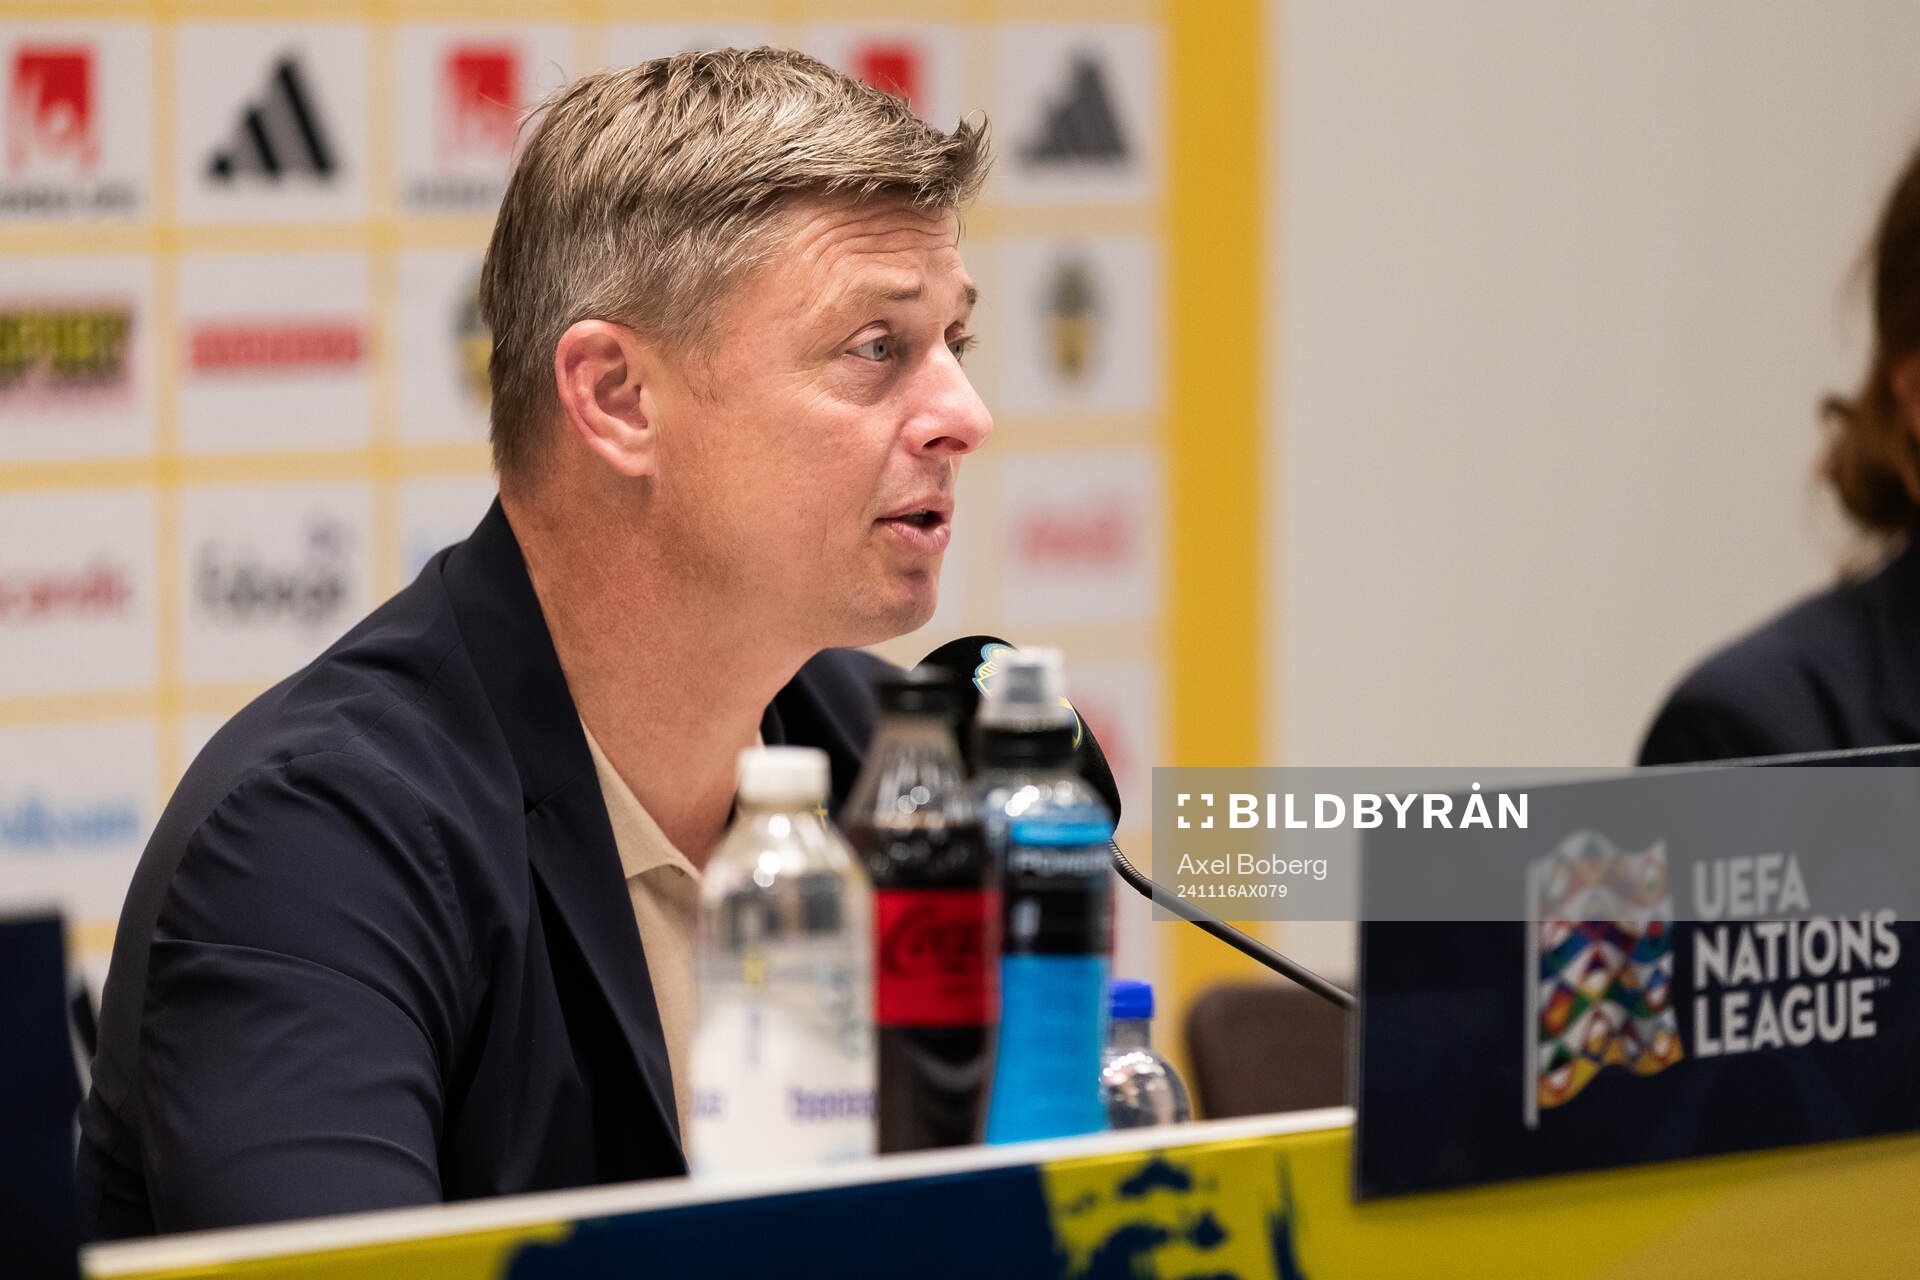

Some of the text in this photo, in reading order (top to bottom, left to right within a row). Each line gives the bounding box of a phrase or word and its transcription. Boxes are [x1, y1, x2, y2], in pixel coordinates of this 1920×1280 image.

[1693, 852, 1810, 921] UEFA
[1694, 909, 1900, 991] NATIONS
[1694, 977, 1877, 1058] LEAGUE
